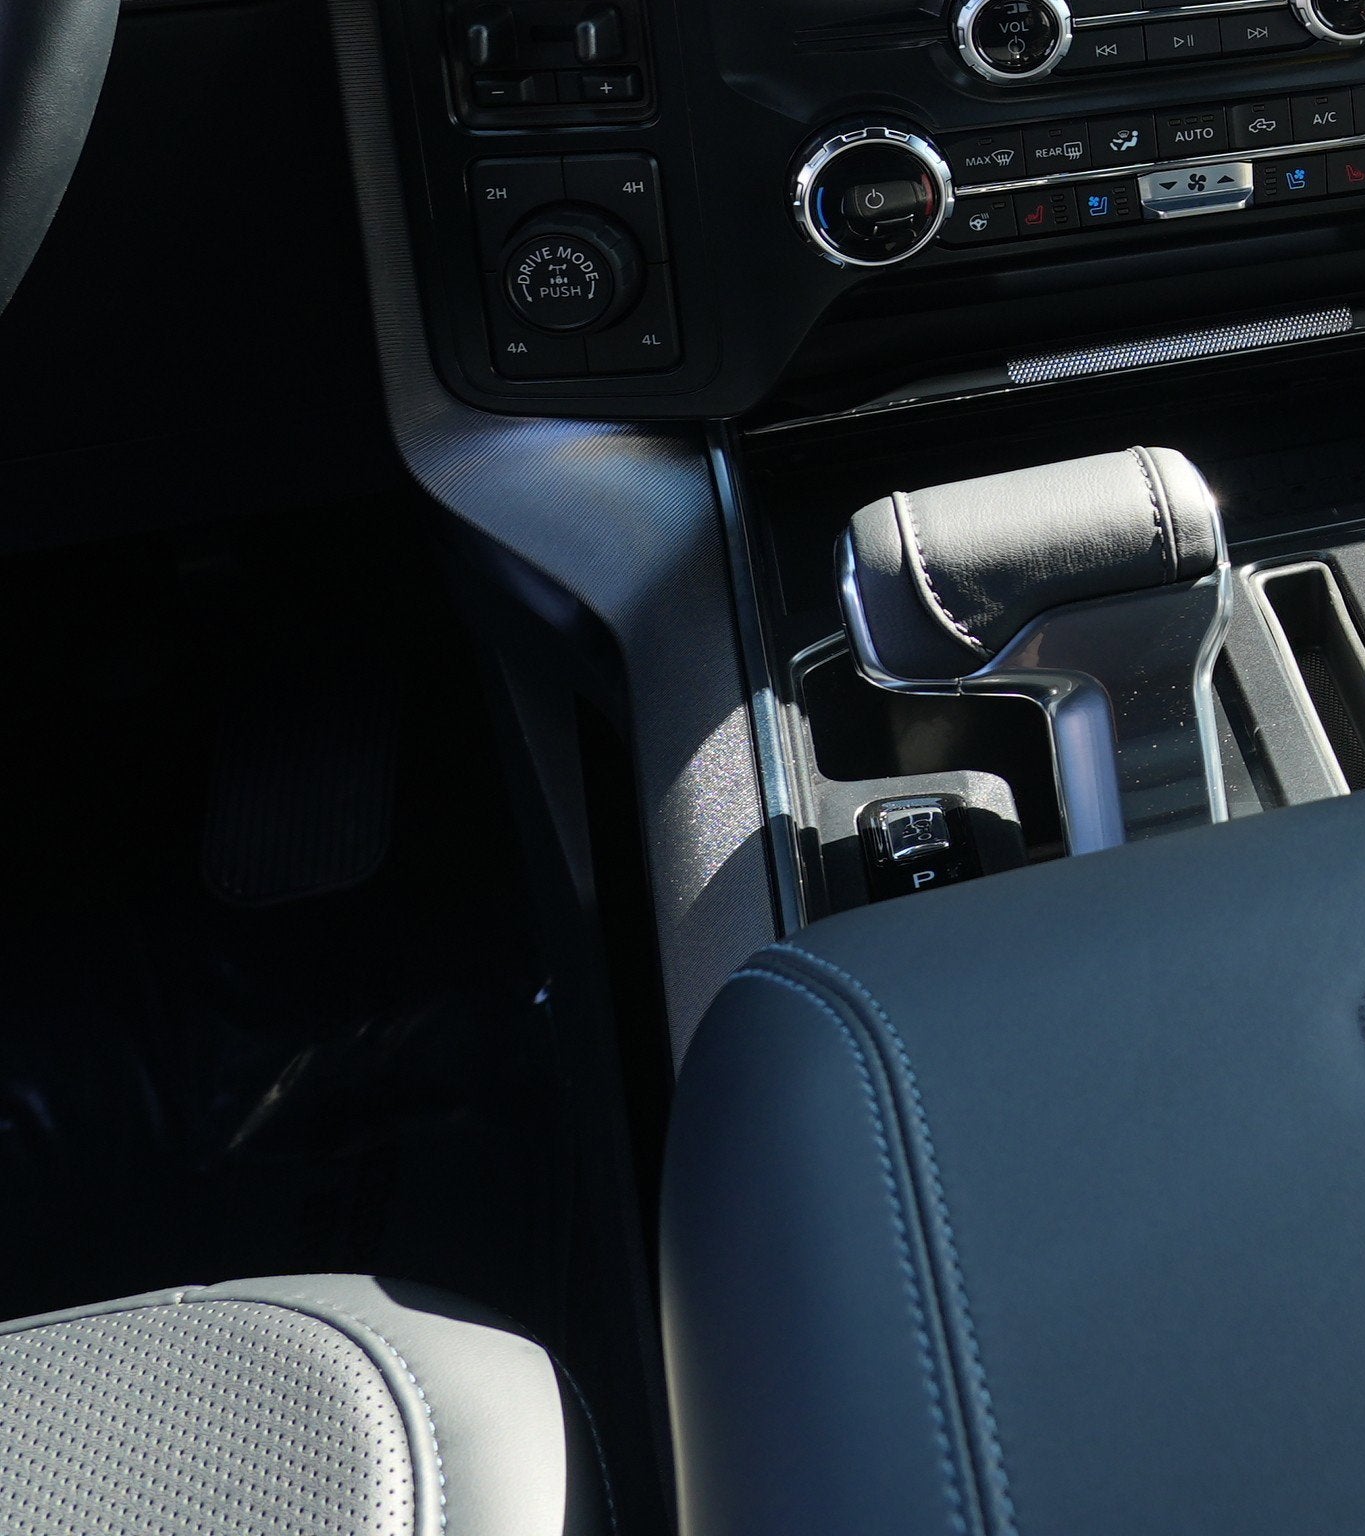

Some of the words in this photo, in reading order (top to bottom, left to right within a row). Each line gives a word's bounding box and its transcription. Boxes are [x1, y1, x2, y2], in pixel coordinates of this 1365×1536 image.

[999, 21, 1030, 34] VOL
[1313, 110, 1337, 125] A/C
[1175, 128, 1214, 142] AUTO
[1036, 147, 1063, 158] REAR
[966, 155, 992, 167] MAX
[486, 187, 507, 200] 2H
[622, 181, 644, 193] 4H
[517, 246, 553, 285] DRIVE
[556, 245, 599, 282] MODE
[540, 285, 582, 298] PUSH
[641, 334, 661, 346] 4L
[507, 342, 528, 354] 4A
[912, 870, 935, 888] P
